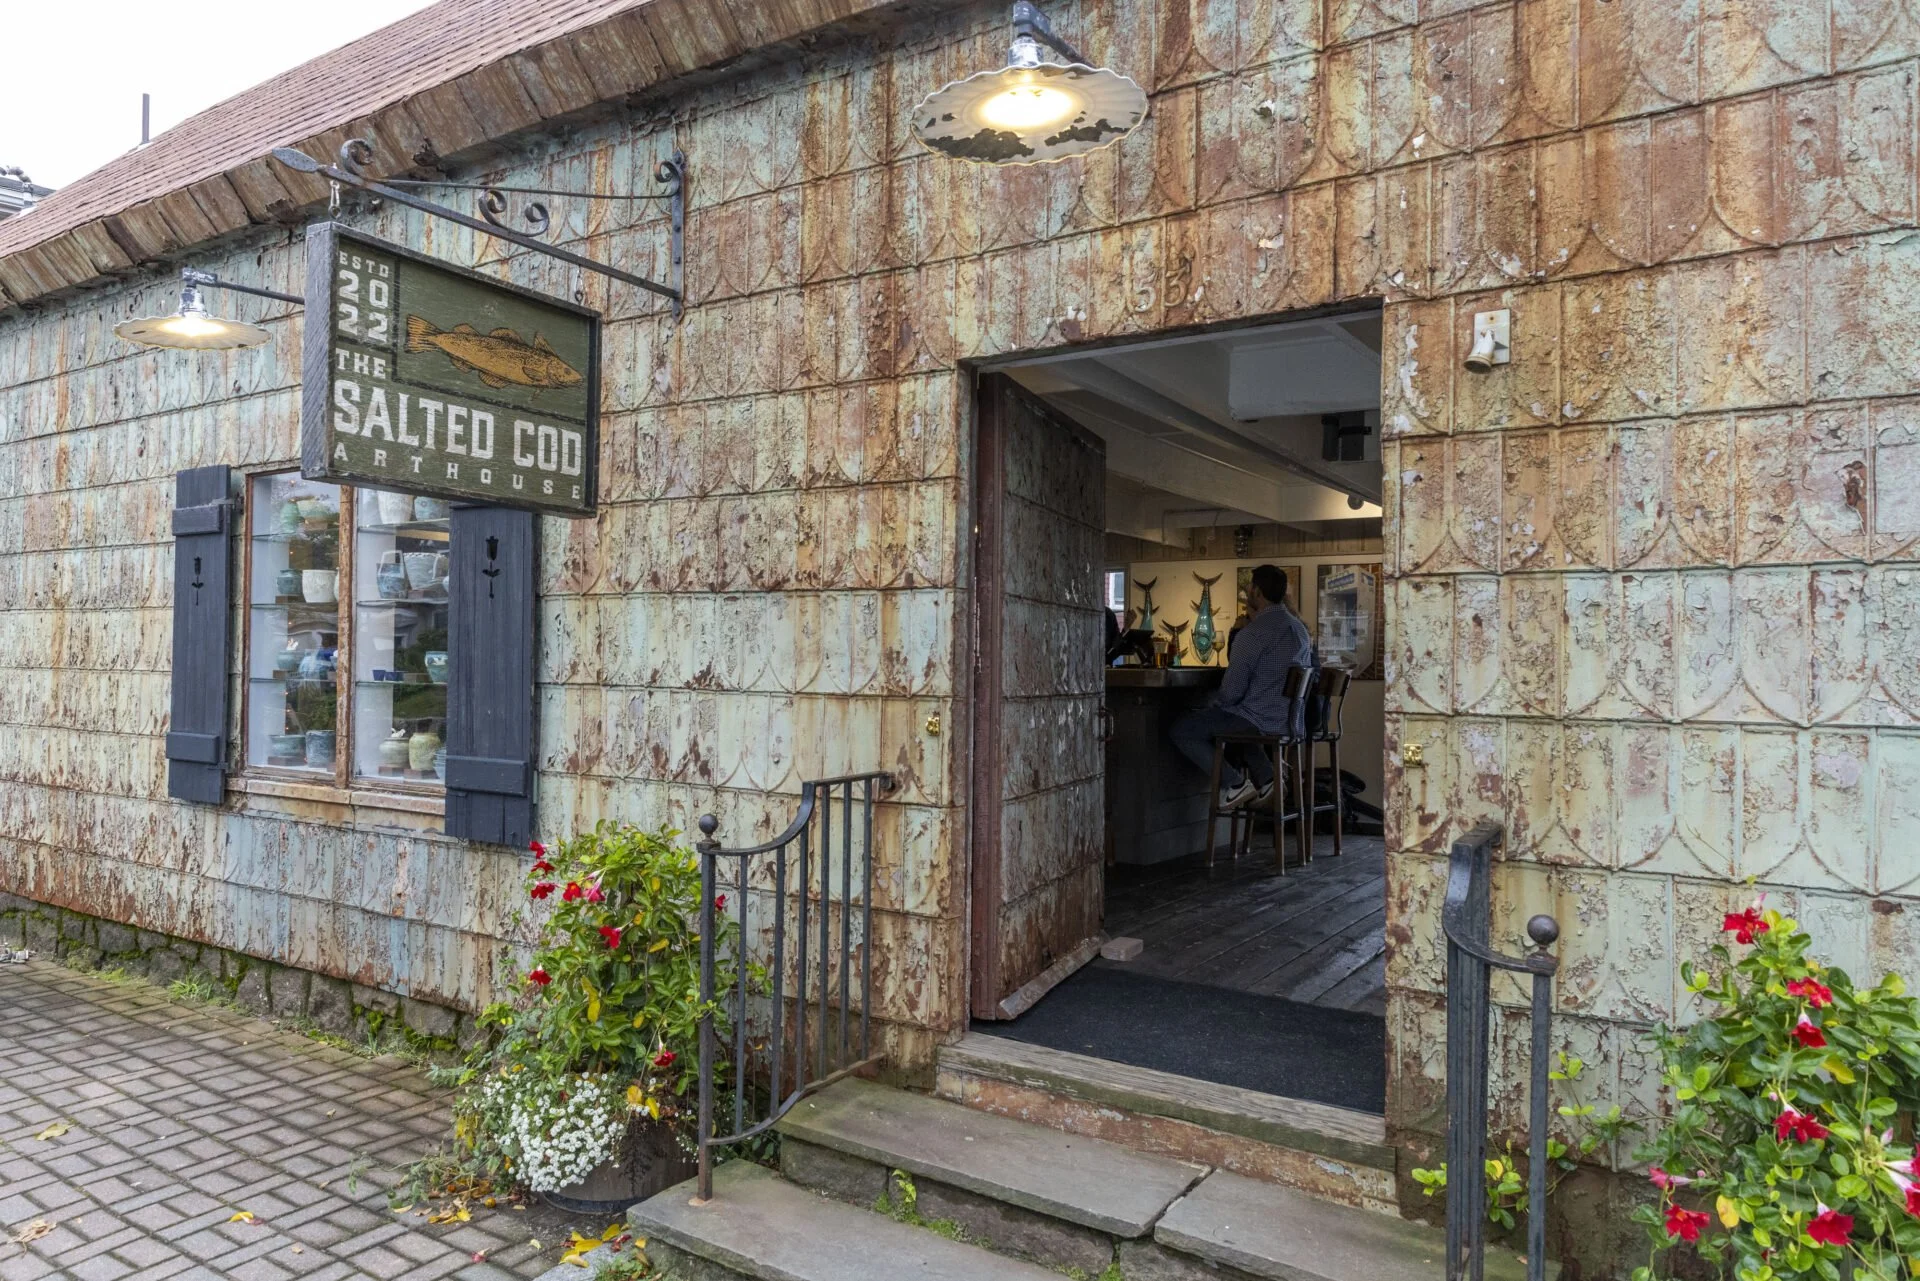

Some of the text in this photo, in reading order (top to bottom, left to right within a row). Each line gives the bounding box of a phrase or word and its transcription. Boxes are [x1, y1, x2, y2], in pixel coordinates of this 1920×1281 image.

[339, 250, 389, 278] ESTD
[339, 269, 389, 309] 20
[338, 302, 388, 343] 22
[335, 347, 386, 379] THE
[333, 379, 582, 477] SALTED COD
